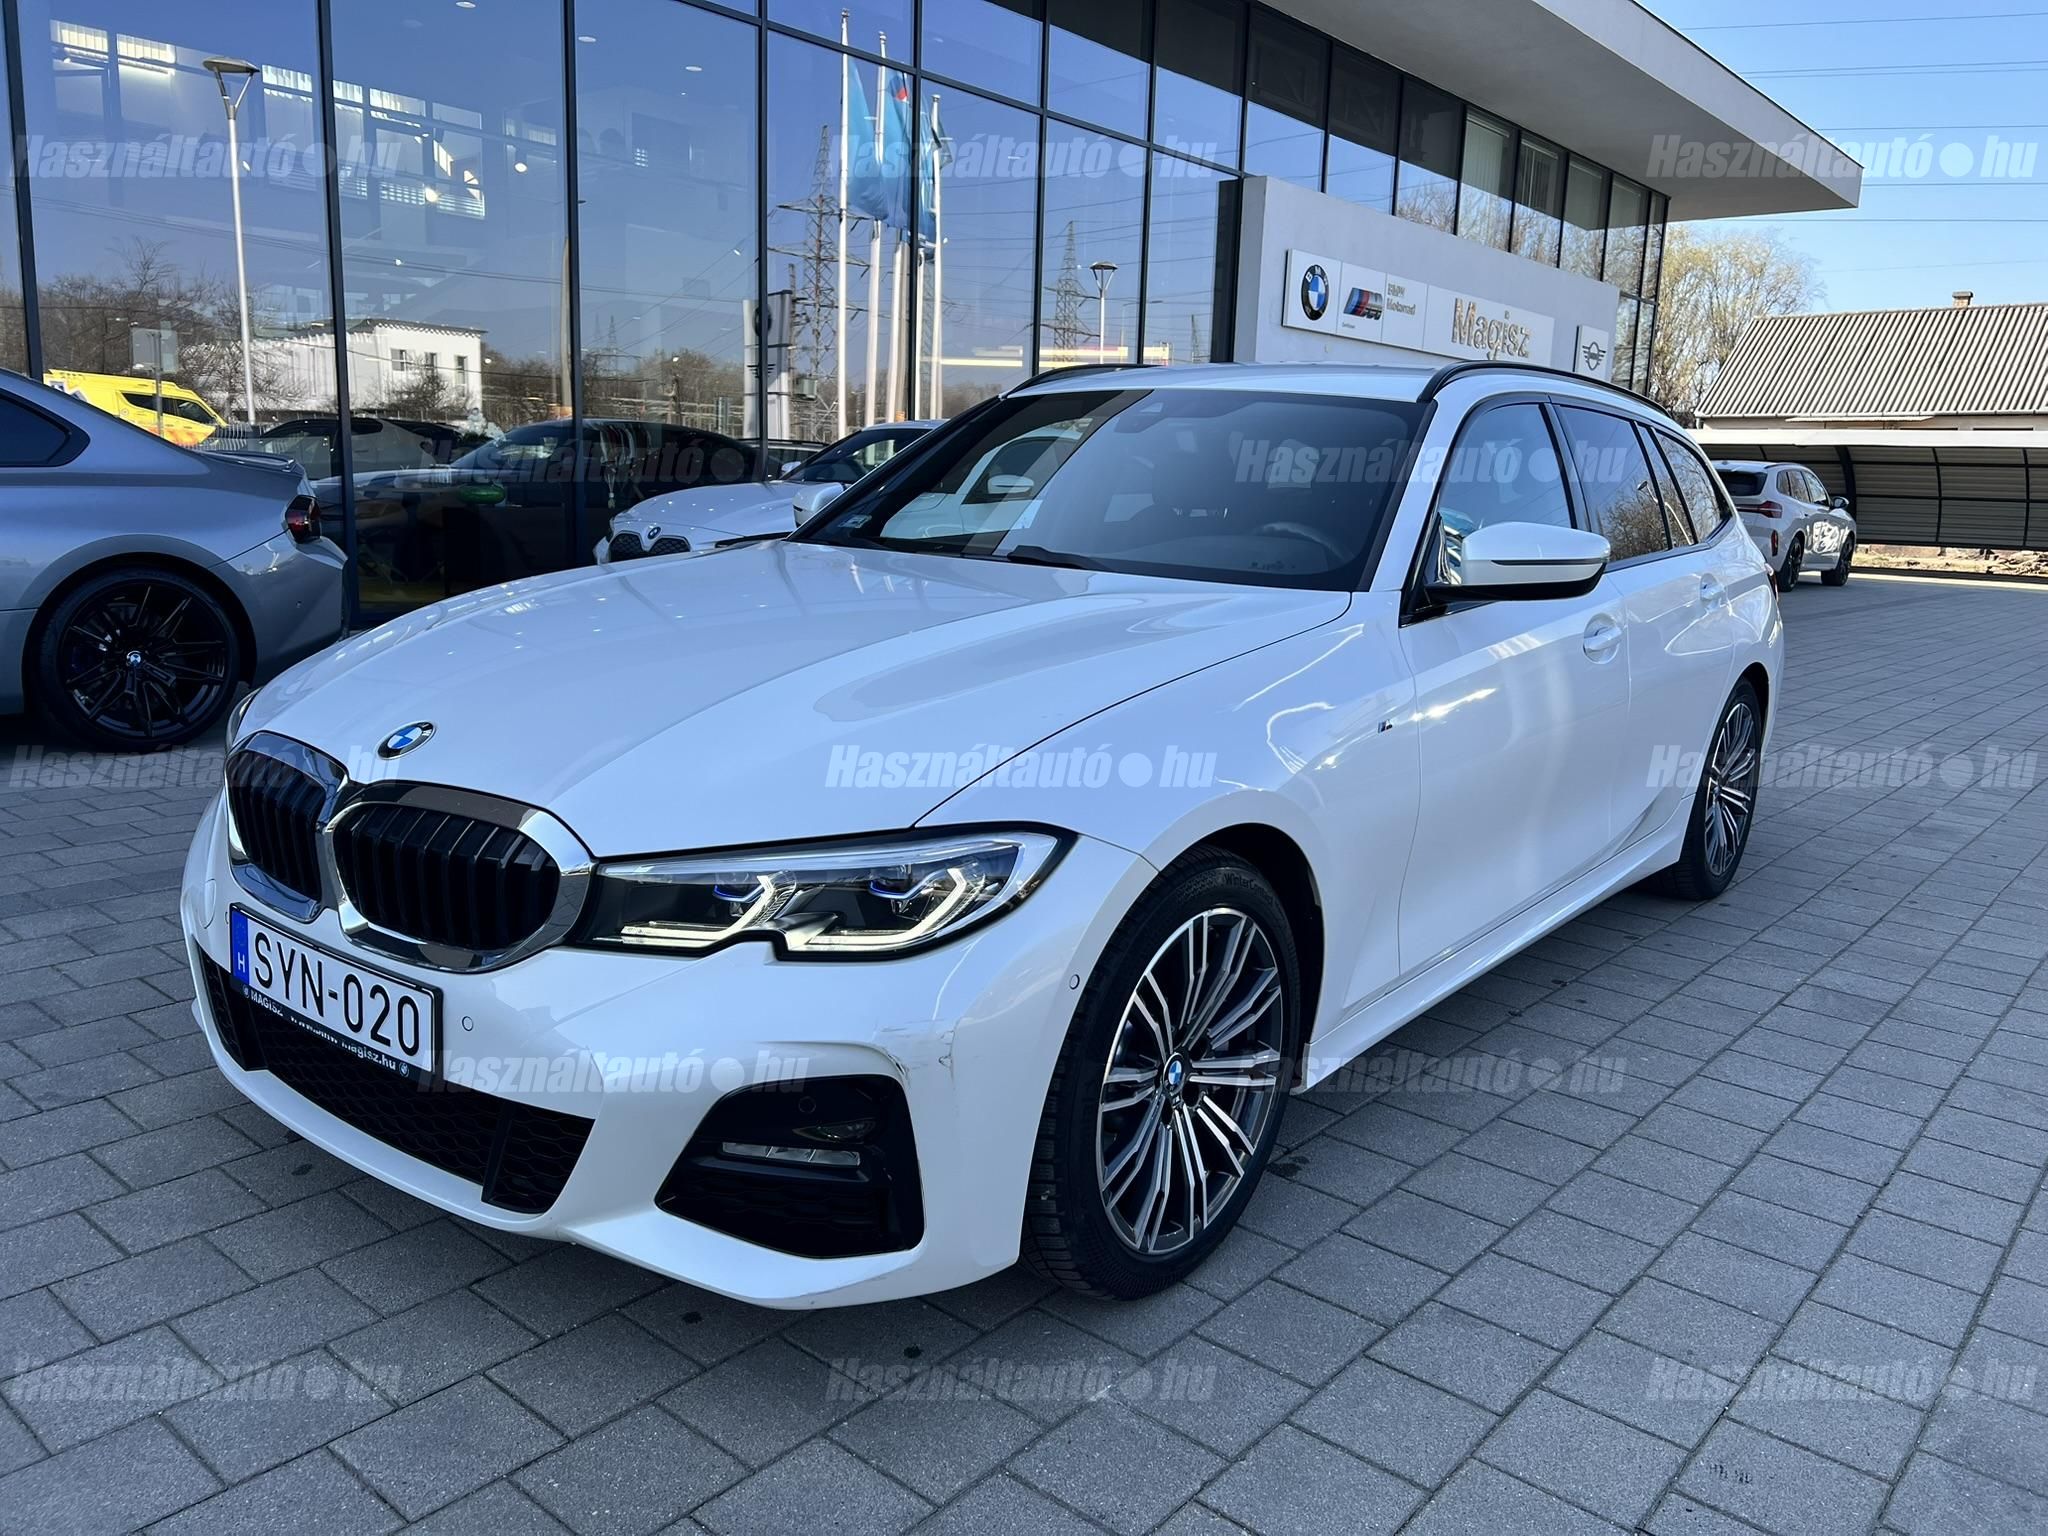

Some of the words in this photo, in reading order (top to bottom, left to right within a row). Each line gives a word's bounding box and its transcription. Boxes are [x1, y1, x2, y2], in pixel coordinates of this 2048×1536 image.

[1452, 298, 1530, 360] Magisz
[237, 953, 246, 973] H
[254, 931, 420, 1058] SYN-020
